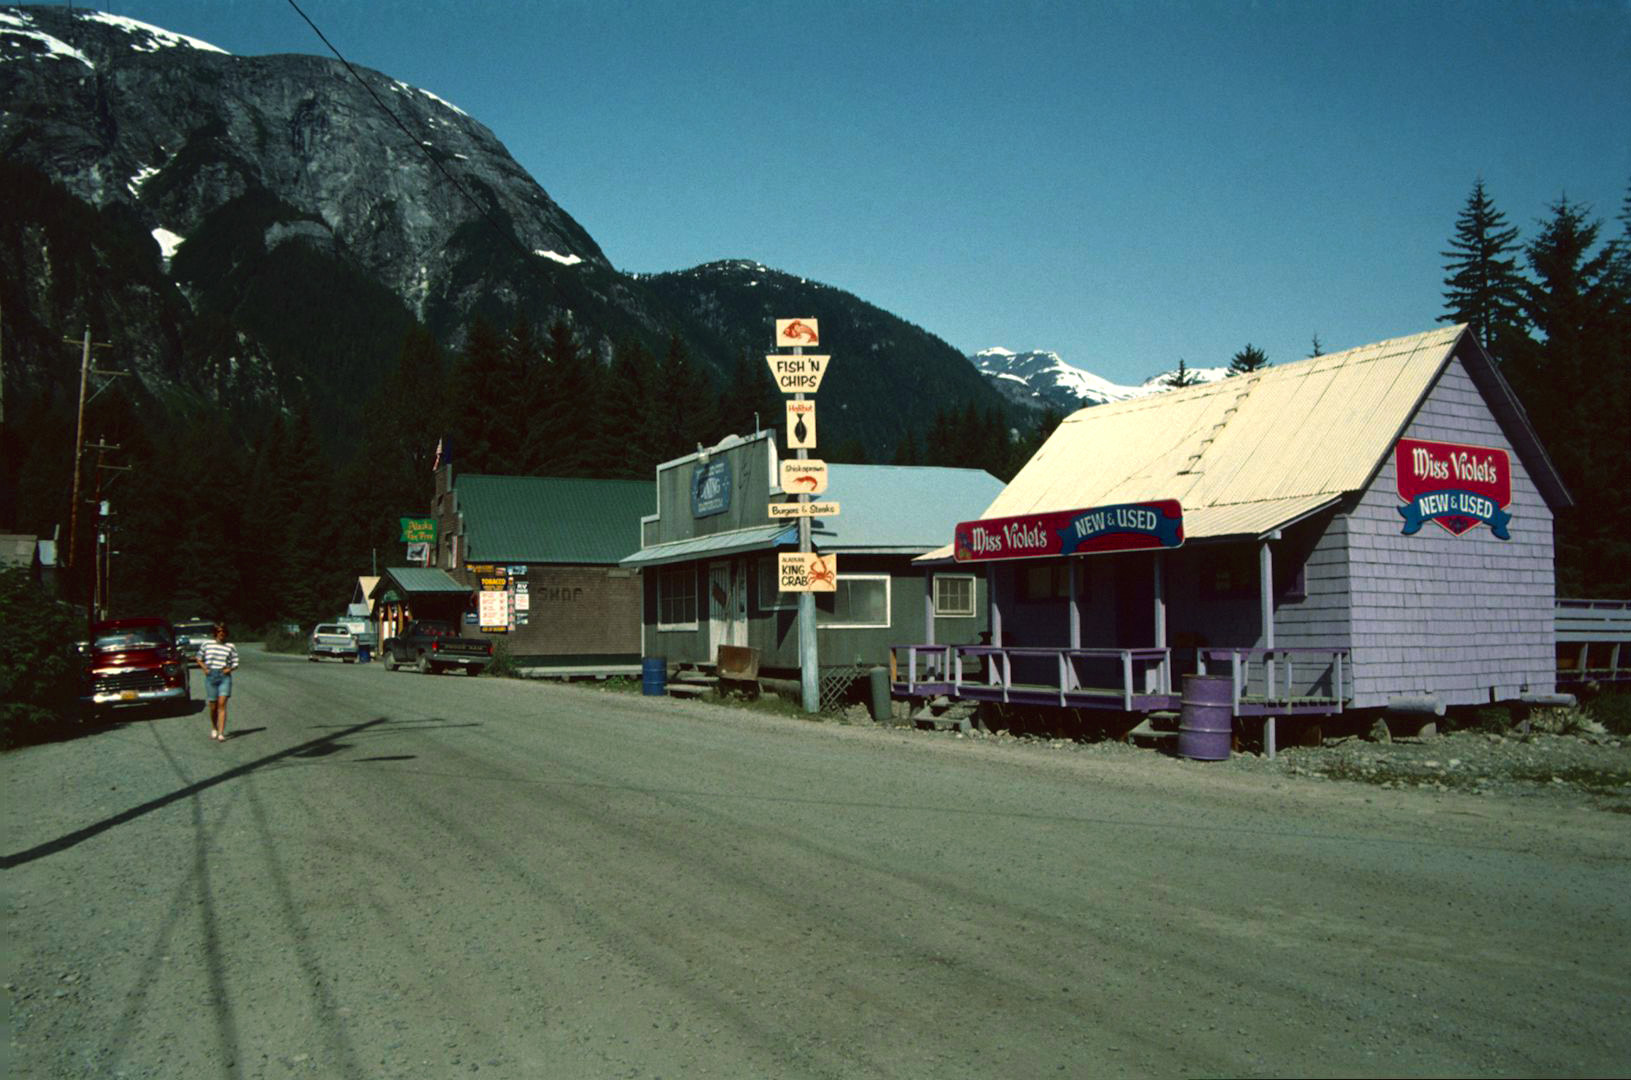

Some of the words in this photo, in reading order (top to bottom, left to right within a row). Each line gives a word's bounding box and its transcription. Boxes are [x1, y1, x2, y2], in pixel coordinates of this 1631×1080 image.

[776, 360, 805, 373] FISH
[780, 375, 817, 388] CHIPS
[1412, 447, 1449, 481] Miss
[1450, 451, 1498, 484] Violet's
[771, 505, 800, 517] Burgers
[801, 504, 808, 513] &
[809, 503, 835, 514] Steaks
[1418, 493, 1449, 517] NEW
[1450, 495, 1458, 509] &
[1459, 493, 1494, 519] USED
[1075, 511, 1106, 539] NEW
[1106, 512, 1116, 526] &
[1116, 508, 1158, 531] USED
[972, 527, 1002, 555] Miss
[1002, 520, 1048, 549] Violet's
[781, 564, 805, 576] KING
[781, 575, 809, 587] CRAB
